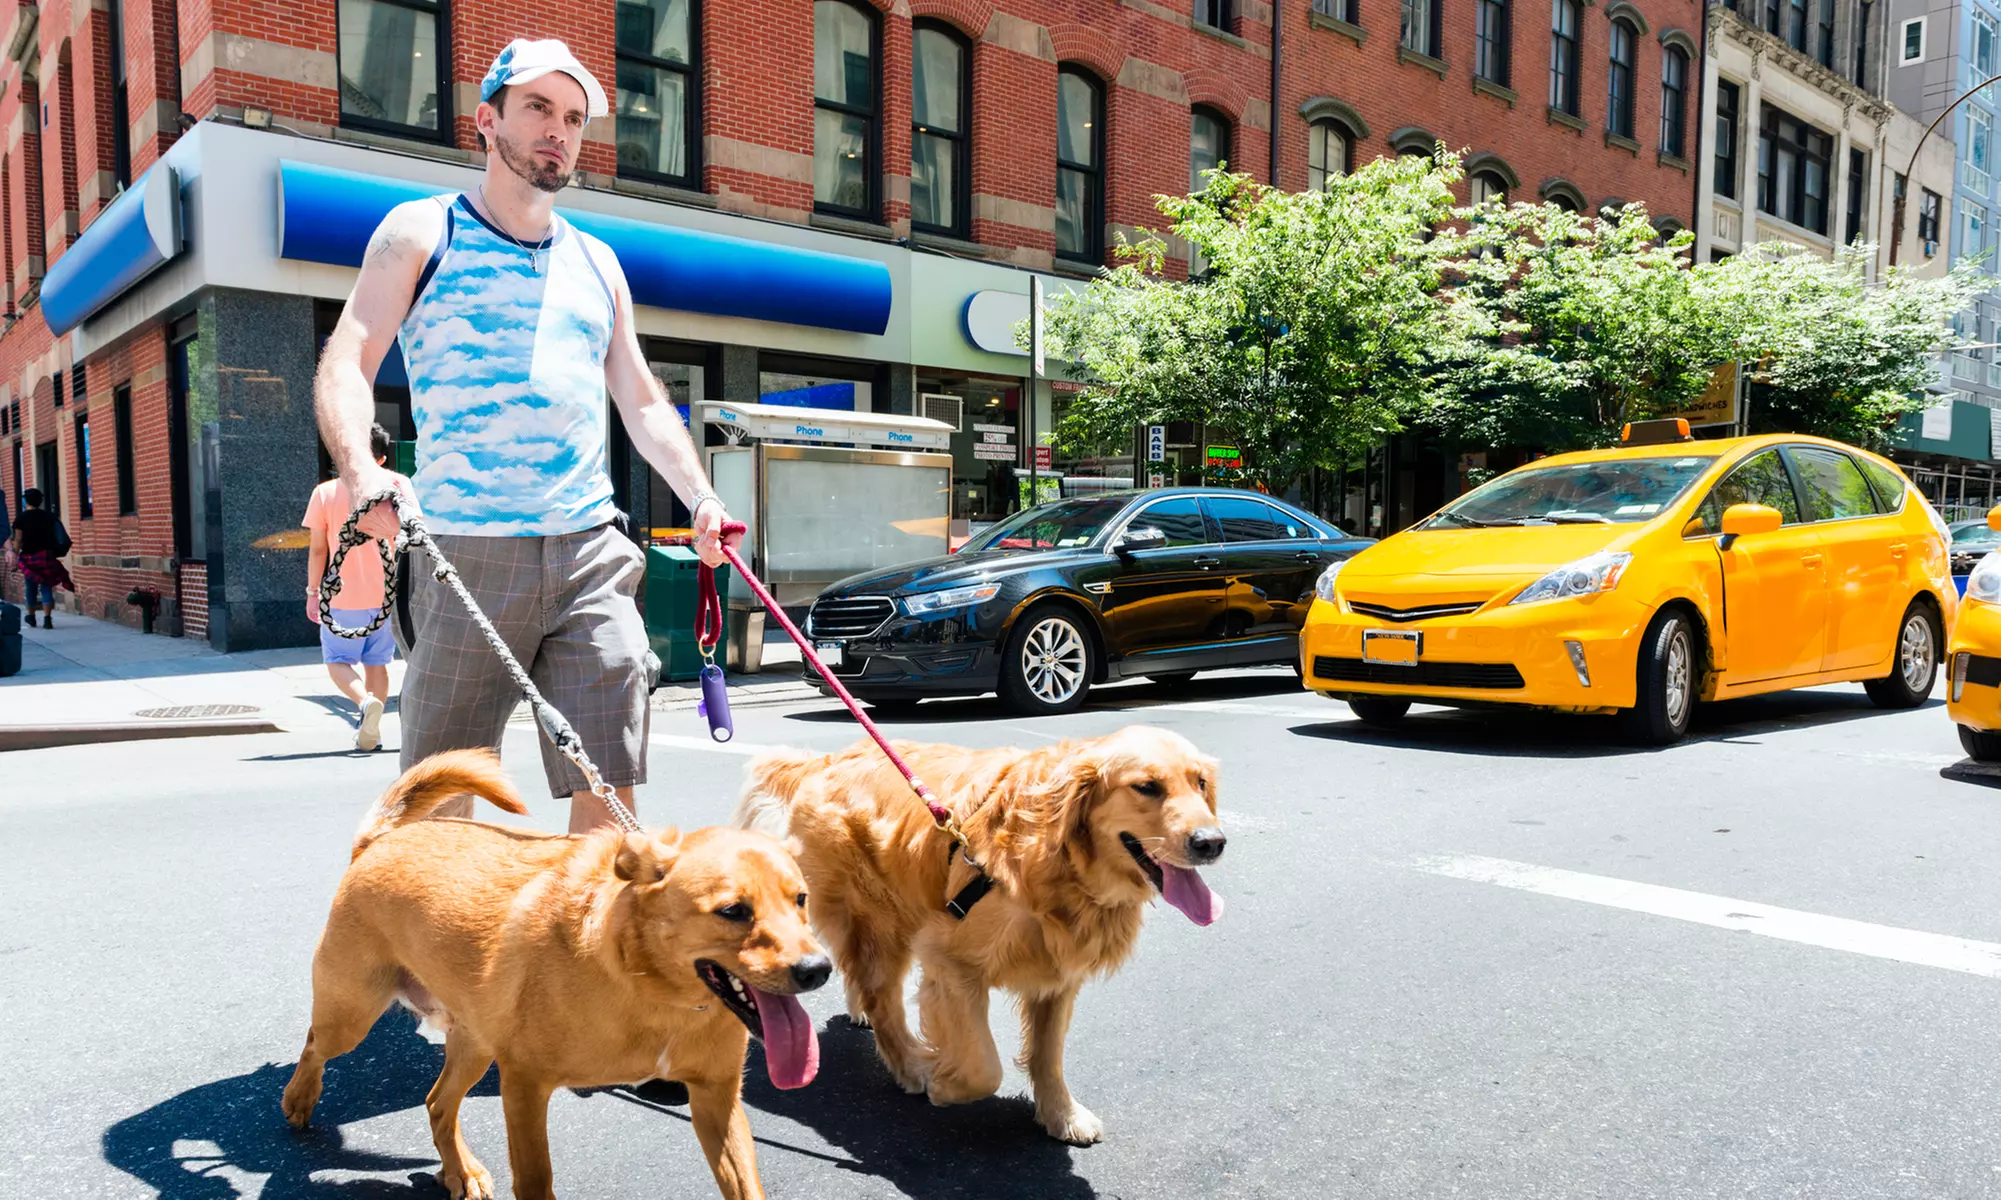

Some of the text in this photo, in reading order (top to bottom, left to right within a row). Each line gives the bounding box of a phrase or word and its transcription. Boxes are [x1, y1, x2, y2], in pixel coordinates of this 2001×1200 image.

[1052, 381, 1072, 390] CUSTOM
[719, 409, 736, 421] Phone
[796, 425, 823, 436] Phone
[888, 431, 913, 442] Phone
[1151, 427, 1162, 475] BARB
